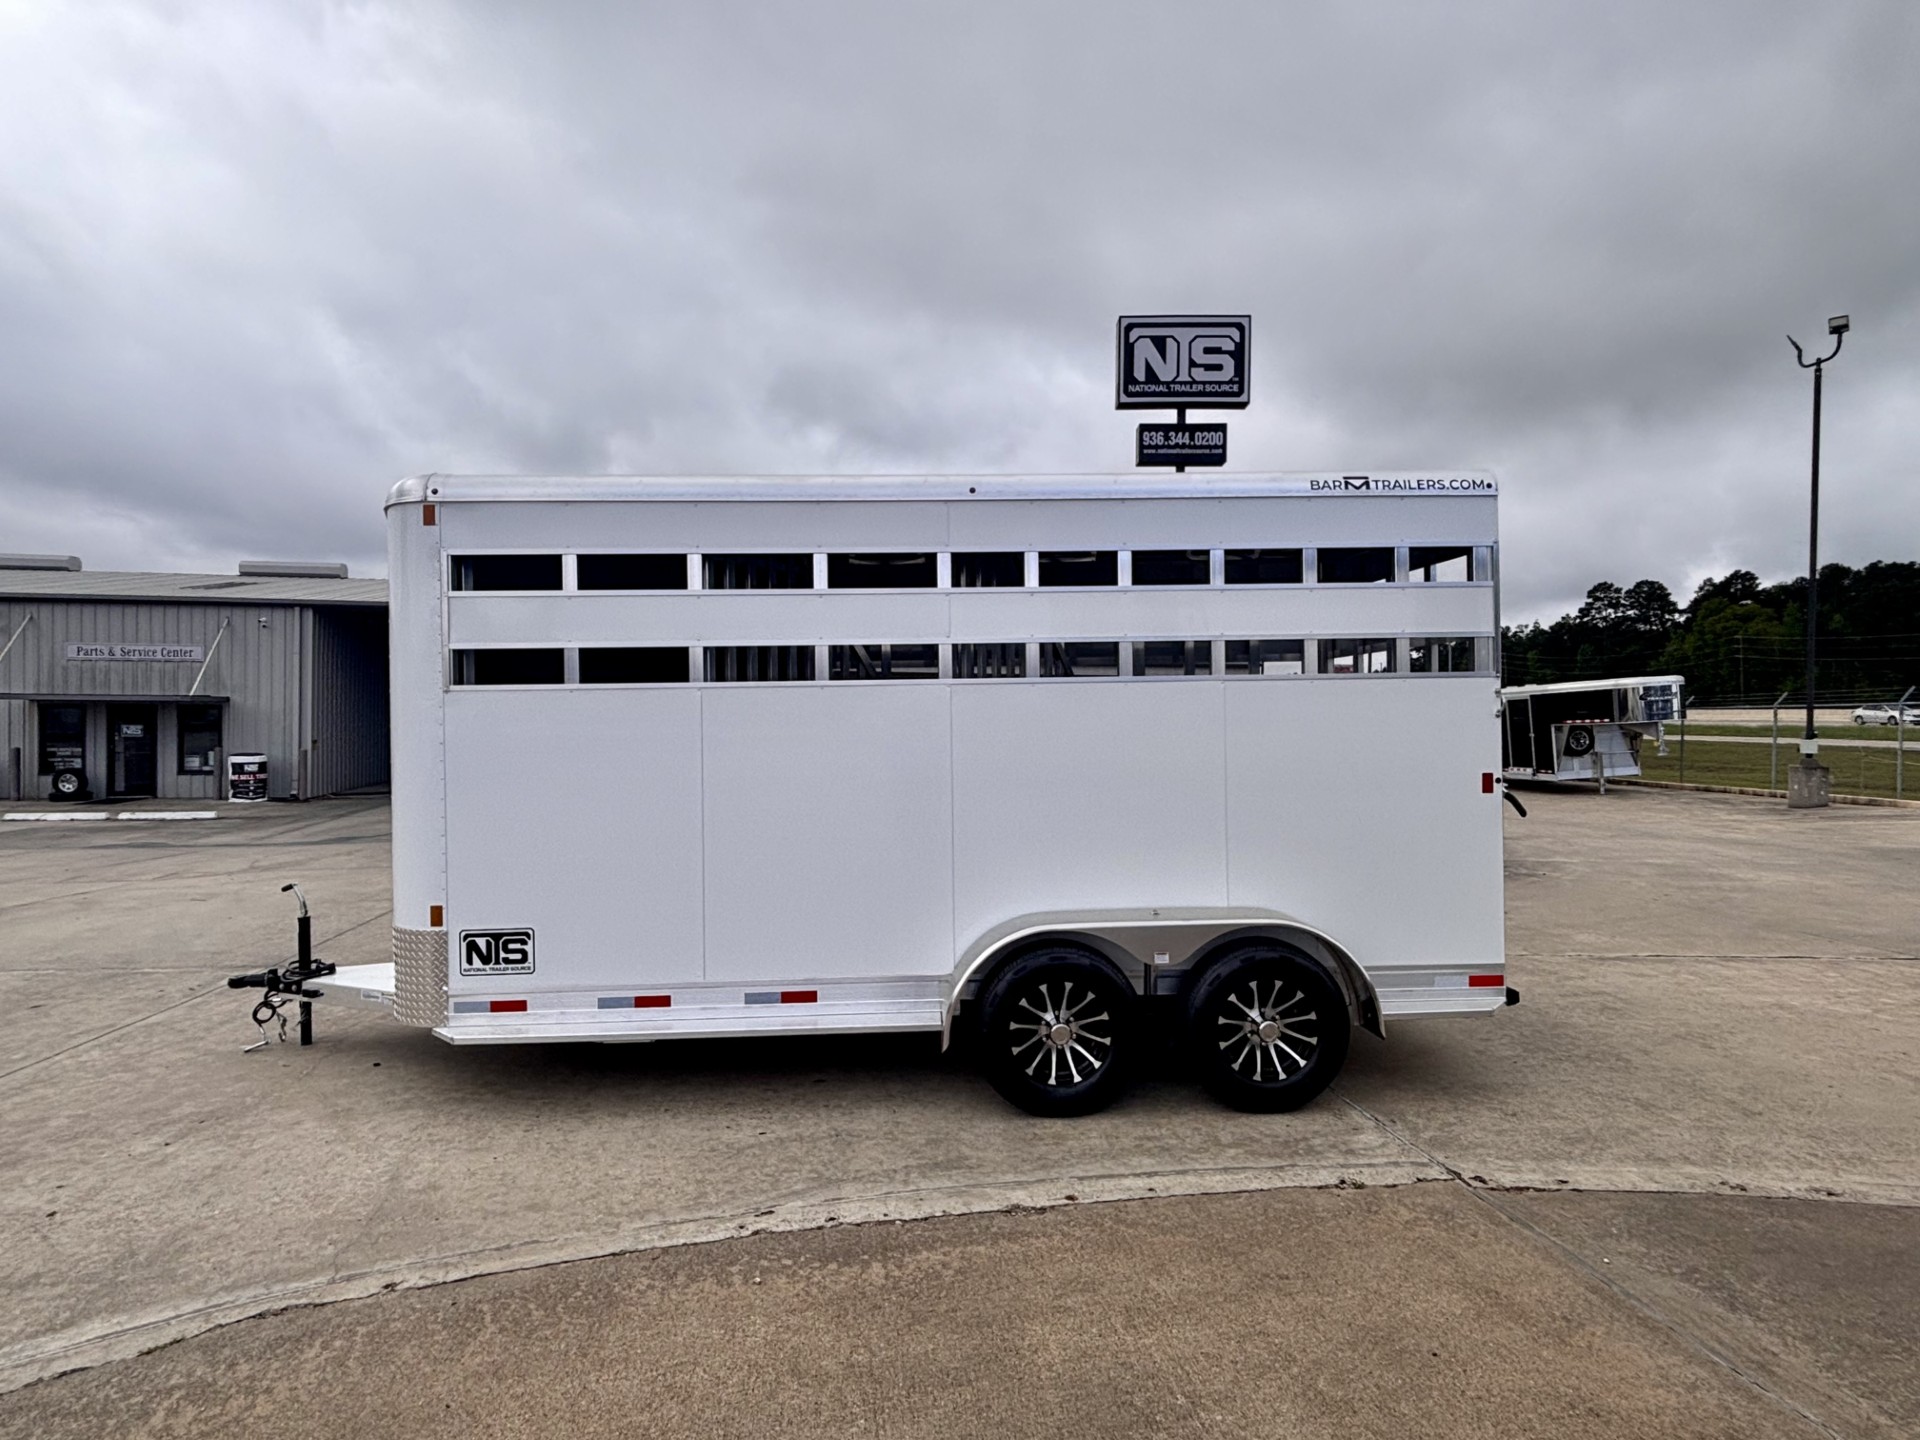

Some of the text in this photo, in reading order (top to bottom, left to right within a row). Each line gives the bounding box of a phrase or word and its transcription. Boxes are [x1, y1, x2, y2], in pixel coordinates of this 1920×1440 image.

[1129, 327, 1240, 382] NTS
[1128, 384, 1239, 392] NATIONAL TRAILER SOURCE
[1143, 431, 1224, 446] 936.344.0200
[76, 646, 194, 658] Parts & Service Center
[463, 931, 531, 966] NTS
